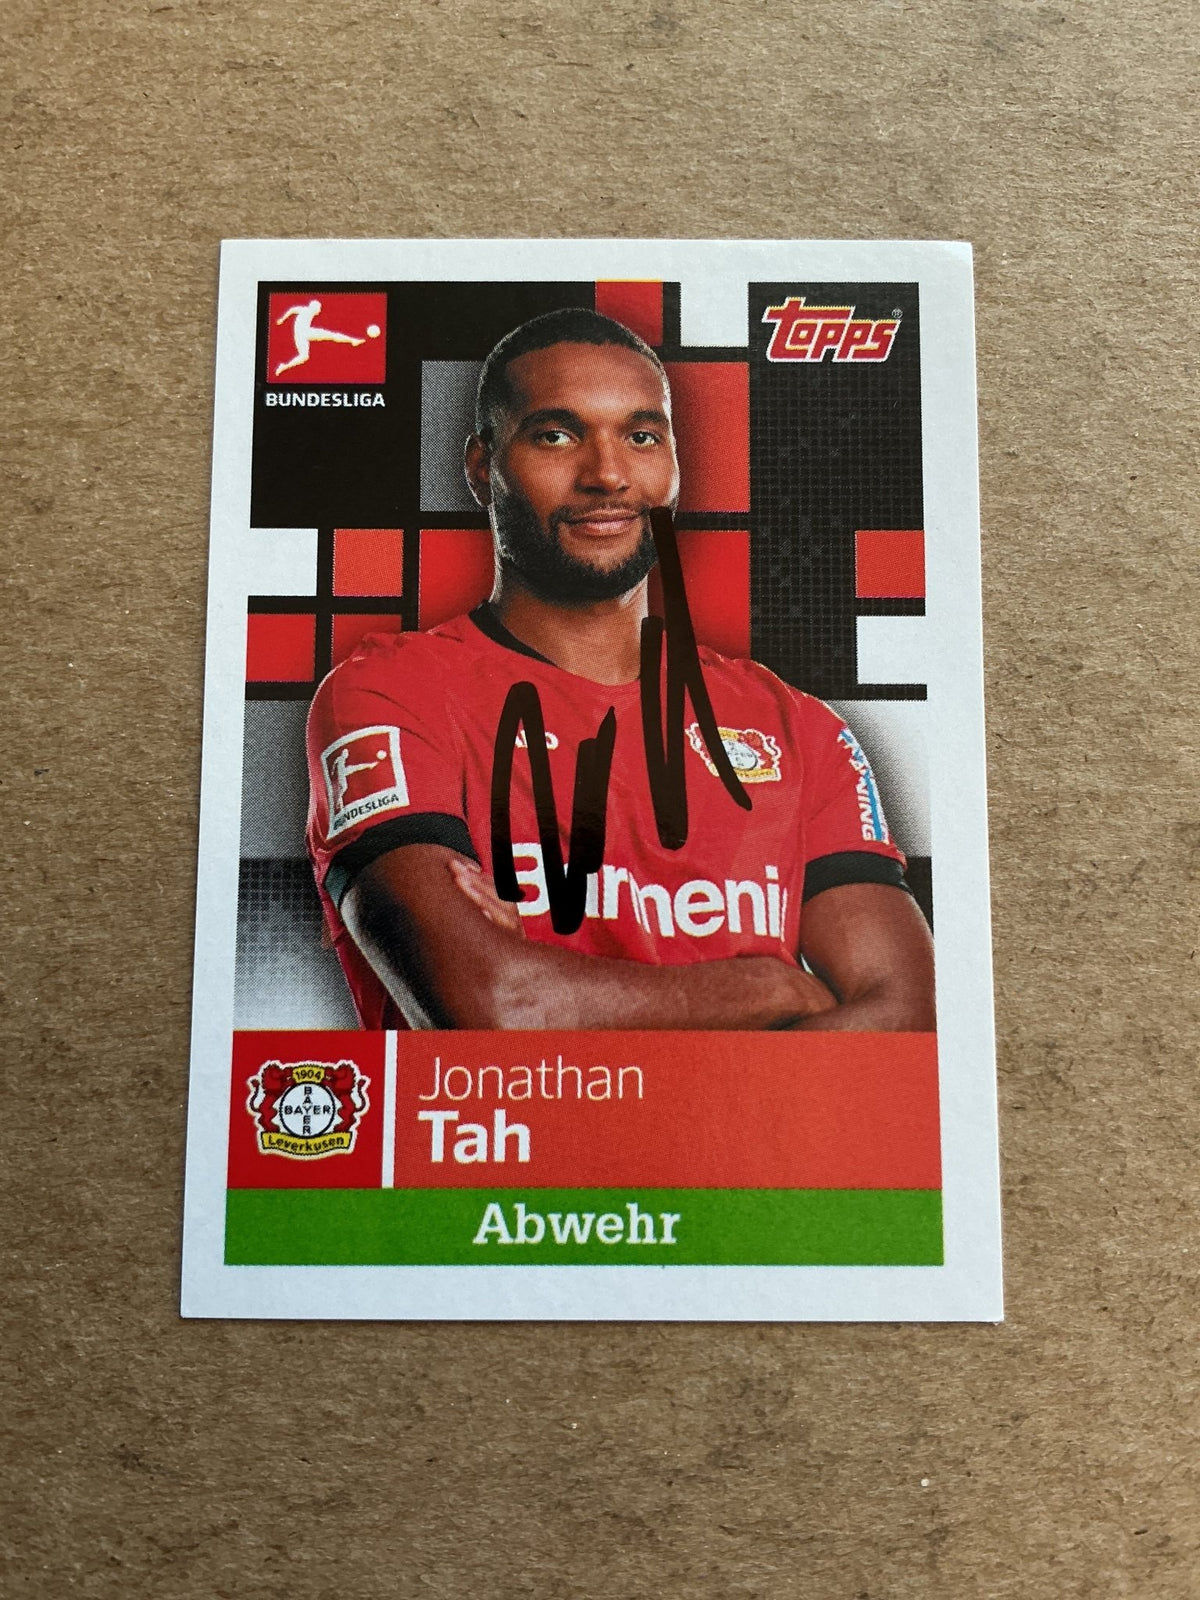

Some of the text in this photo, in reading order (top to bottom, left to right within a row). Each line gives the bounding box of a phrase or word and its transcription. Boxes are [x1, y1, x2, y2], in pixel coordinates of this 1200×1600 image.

[265, 392, 386, 408] BUNDESLIGA
[296, 1070, 321, 1081] 1904
[418, 1055, 644, 1101] Jonathan
[284, 1105, 331, 1115] BAYER
[303, 1086, 312, 1135] BAYER
[268, 1135, 344, 1151] Leverkusen
[417, 1108, 531, 1164] Tah
[471, 1202, 682, 1246] Abwehr
